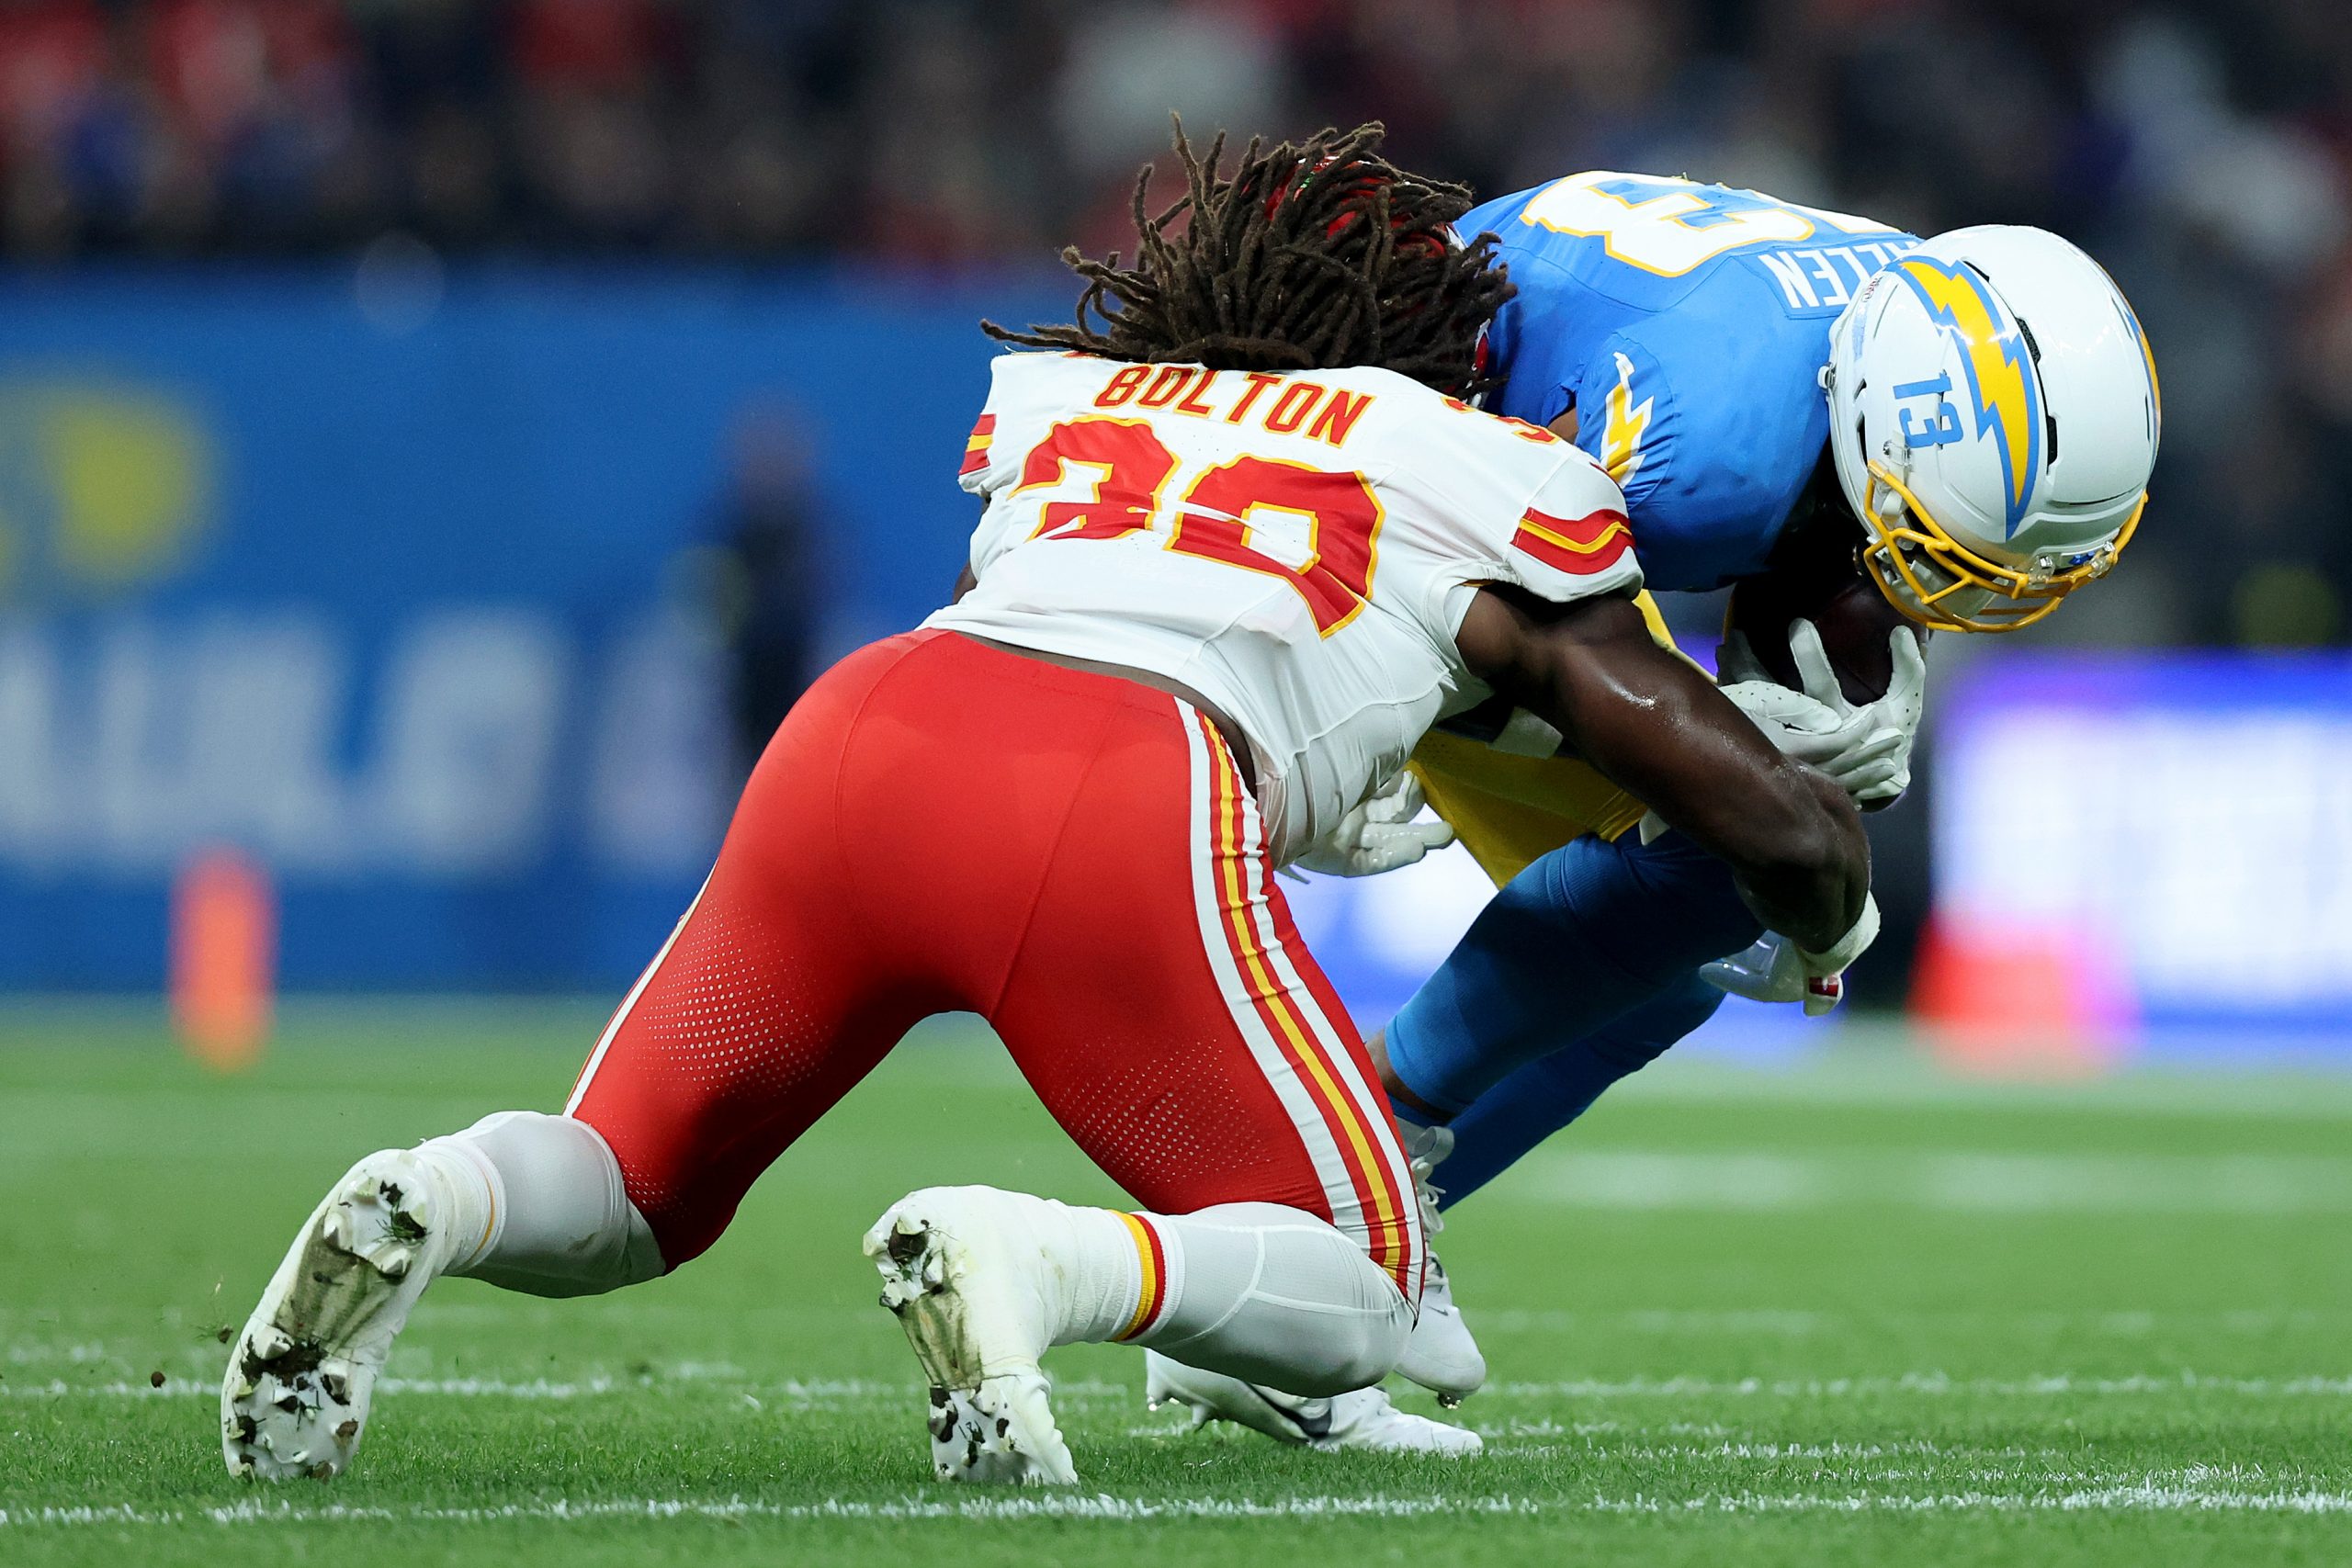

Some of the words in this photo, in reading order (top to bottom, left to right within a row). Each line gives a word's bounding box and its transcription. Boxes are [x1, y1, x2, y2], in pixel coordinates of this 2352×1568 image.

[1758, 241, 1920, 309] LLEN
[1091, 363, 1377, 449] BOLTON
[1892, 372, 1964, 449] 13
